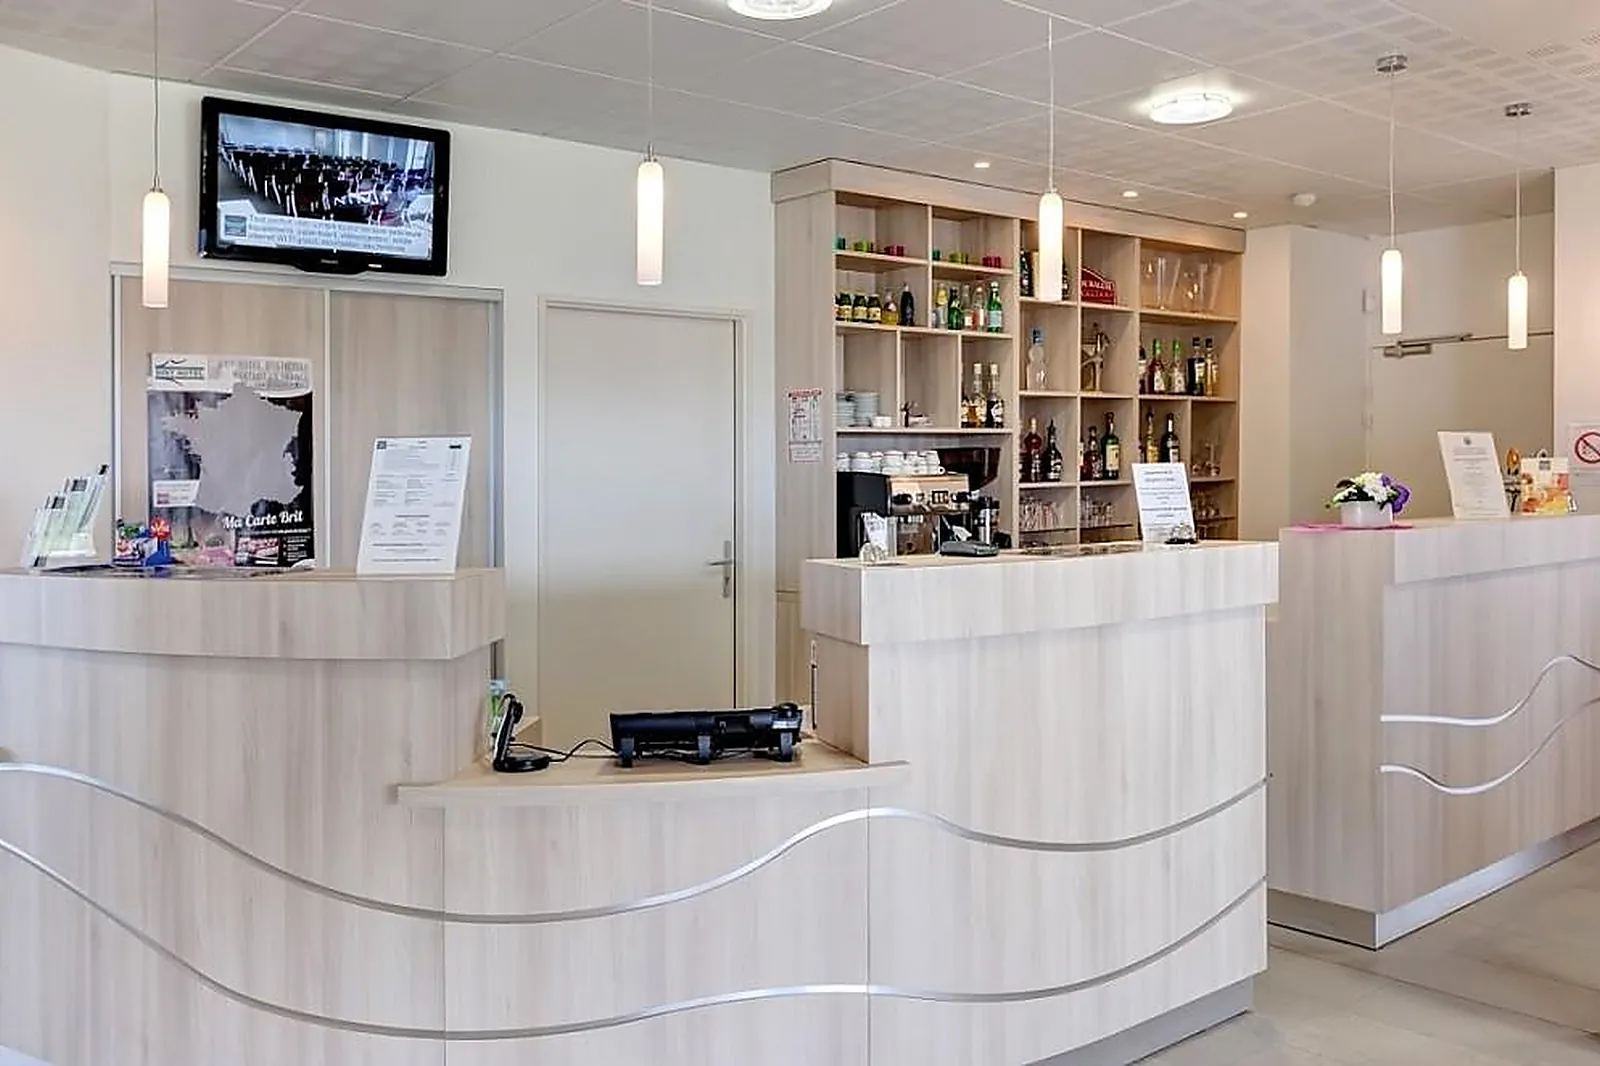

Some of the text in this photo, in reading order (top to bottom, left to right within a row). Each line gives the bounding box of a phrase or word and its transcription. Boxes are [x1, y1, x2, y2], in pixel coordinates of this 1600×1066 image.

[222, 510, 303, 529] Ma Carte Brit
